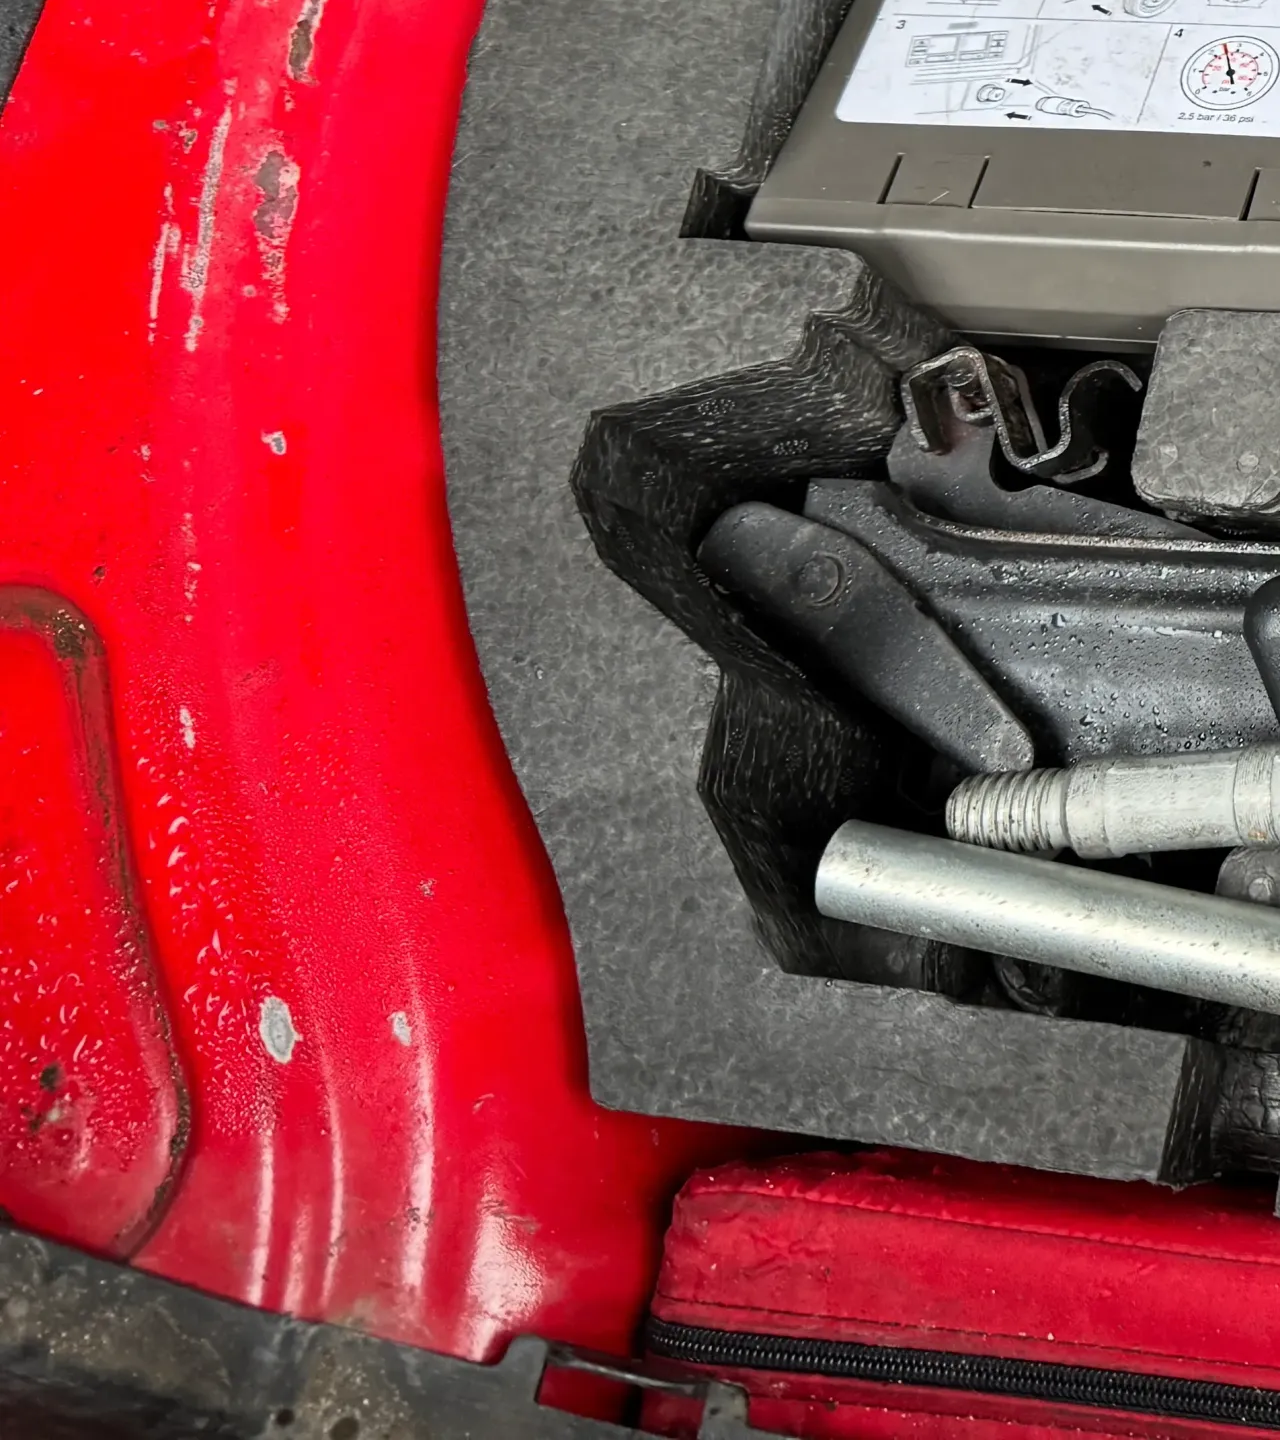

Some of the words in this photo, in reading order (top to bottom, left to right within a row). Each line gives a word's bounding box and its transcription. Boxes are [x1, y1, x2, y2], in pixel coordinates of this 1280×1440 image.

[896, 20, 906, 30] 3
[1174, 28, 1184, 37] 4
[1197, 113, 1214, 121] bar
[1222, 114, 1236, 122] 36
[1238, 116, 1254, 124] psi
